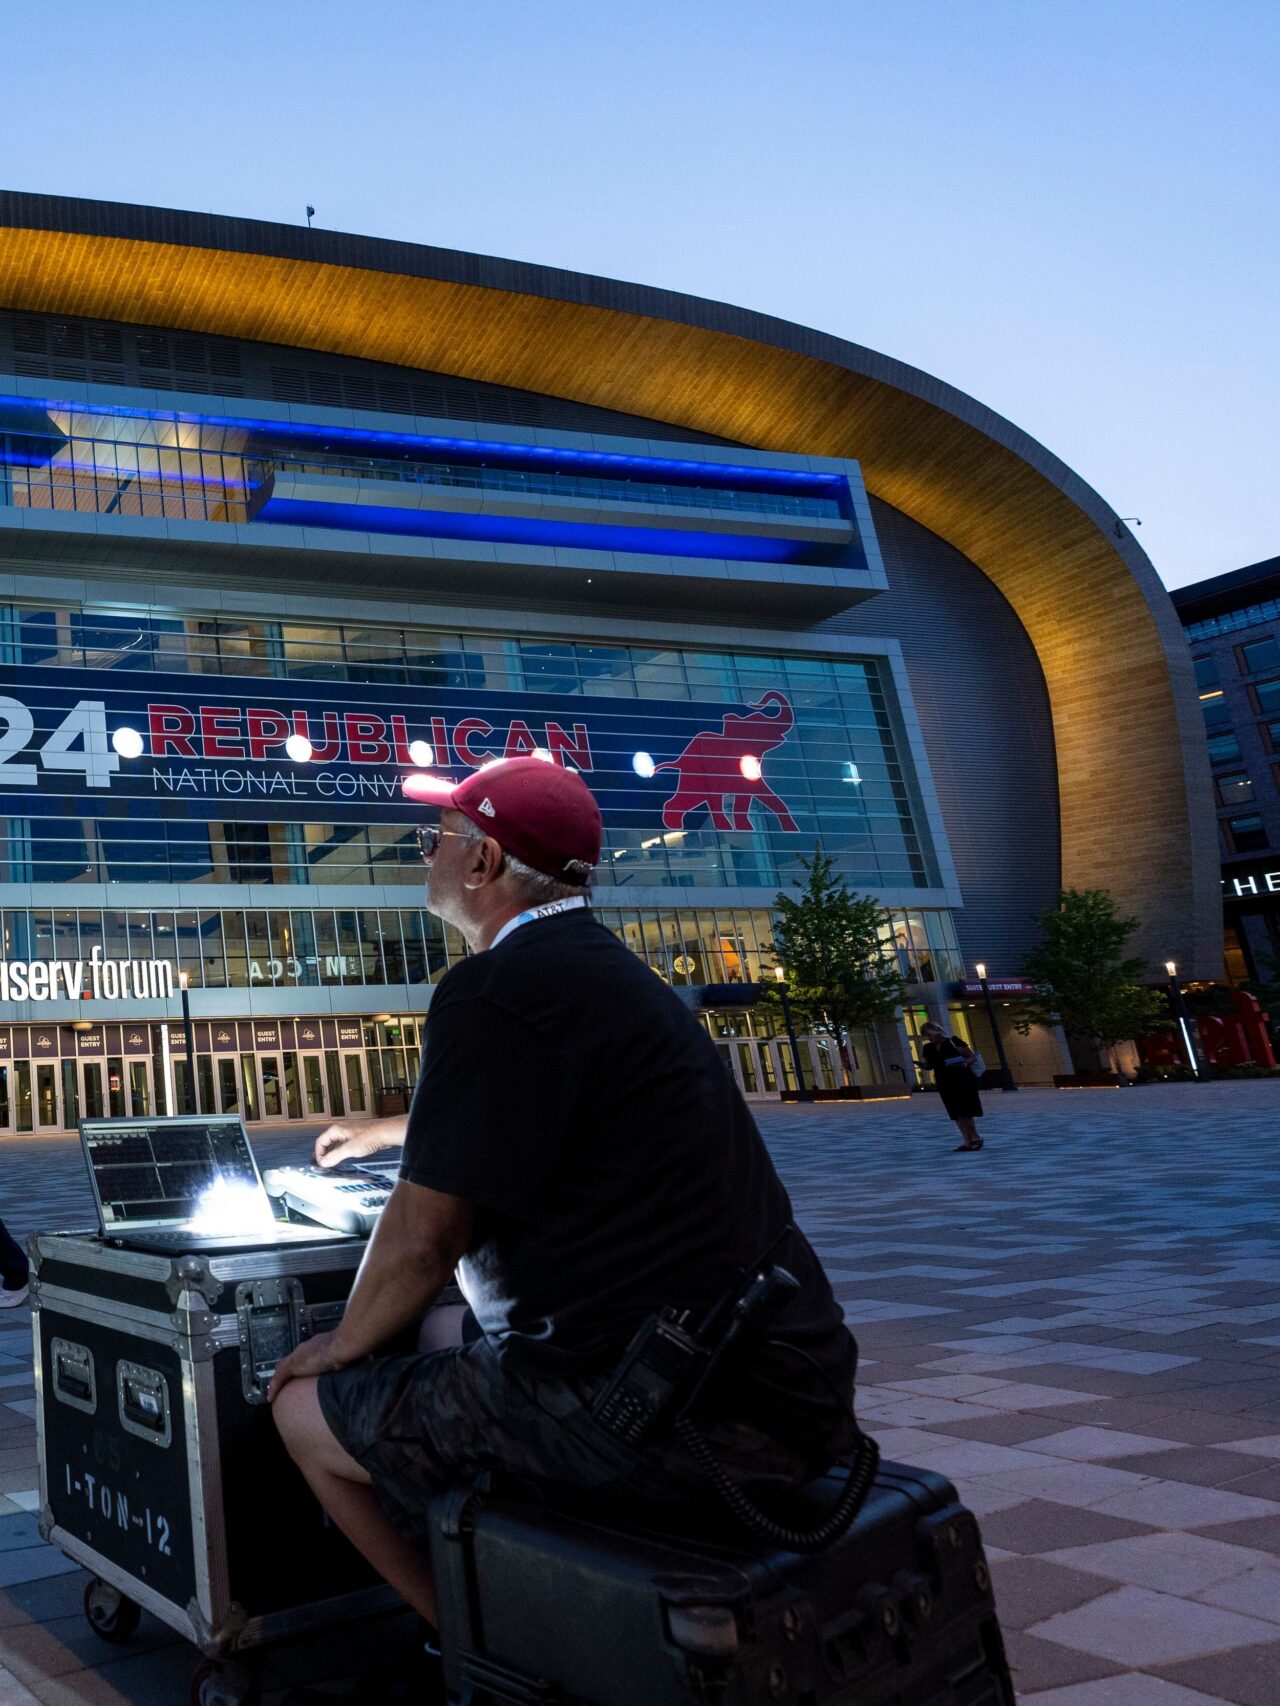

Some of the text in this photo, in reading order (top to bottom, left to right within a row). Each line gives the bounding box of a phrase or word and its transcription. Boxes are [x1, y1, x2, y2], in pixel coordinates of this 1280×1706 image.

[147, 703, 594, 772] REPUBLICAN
[152, 767, 307, 795] NATIONAL
[1221, 872, 1280, 896] HE
